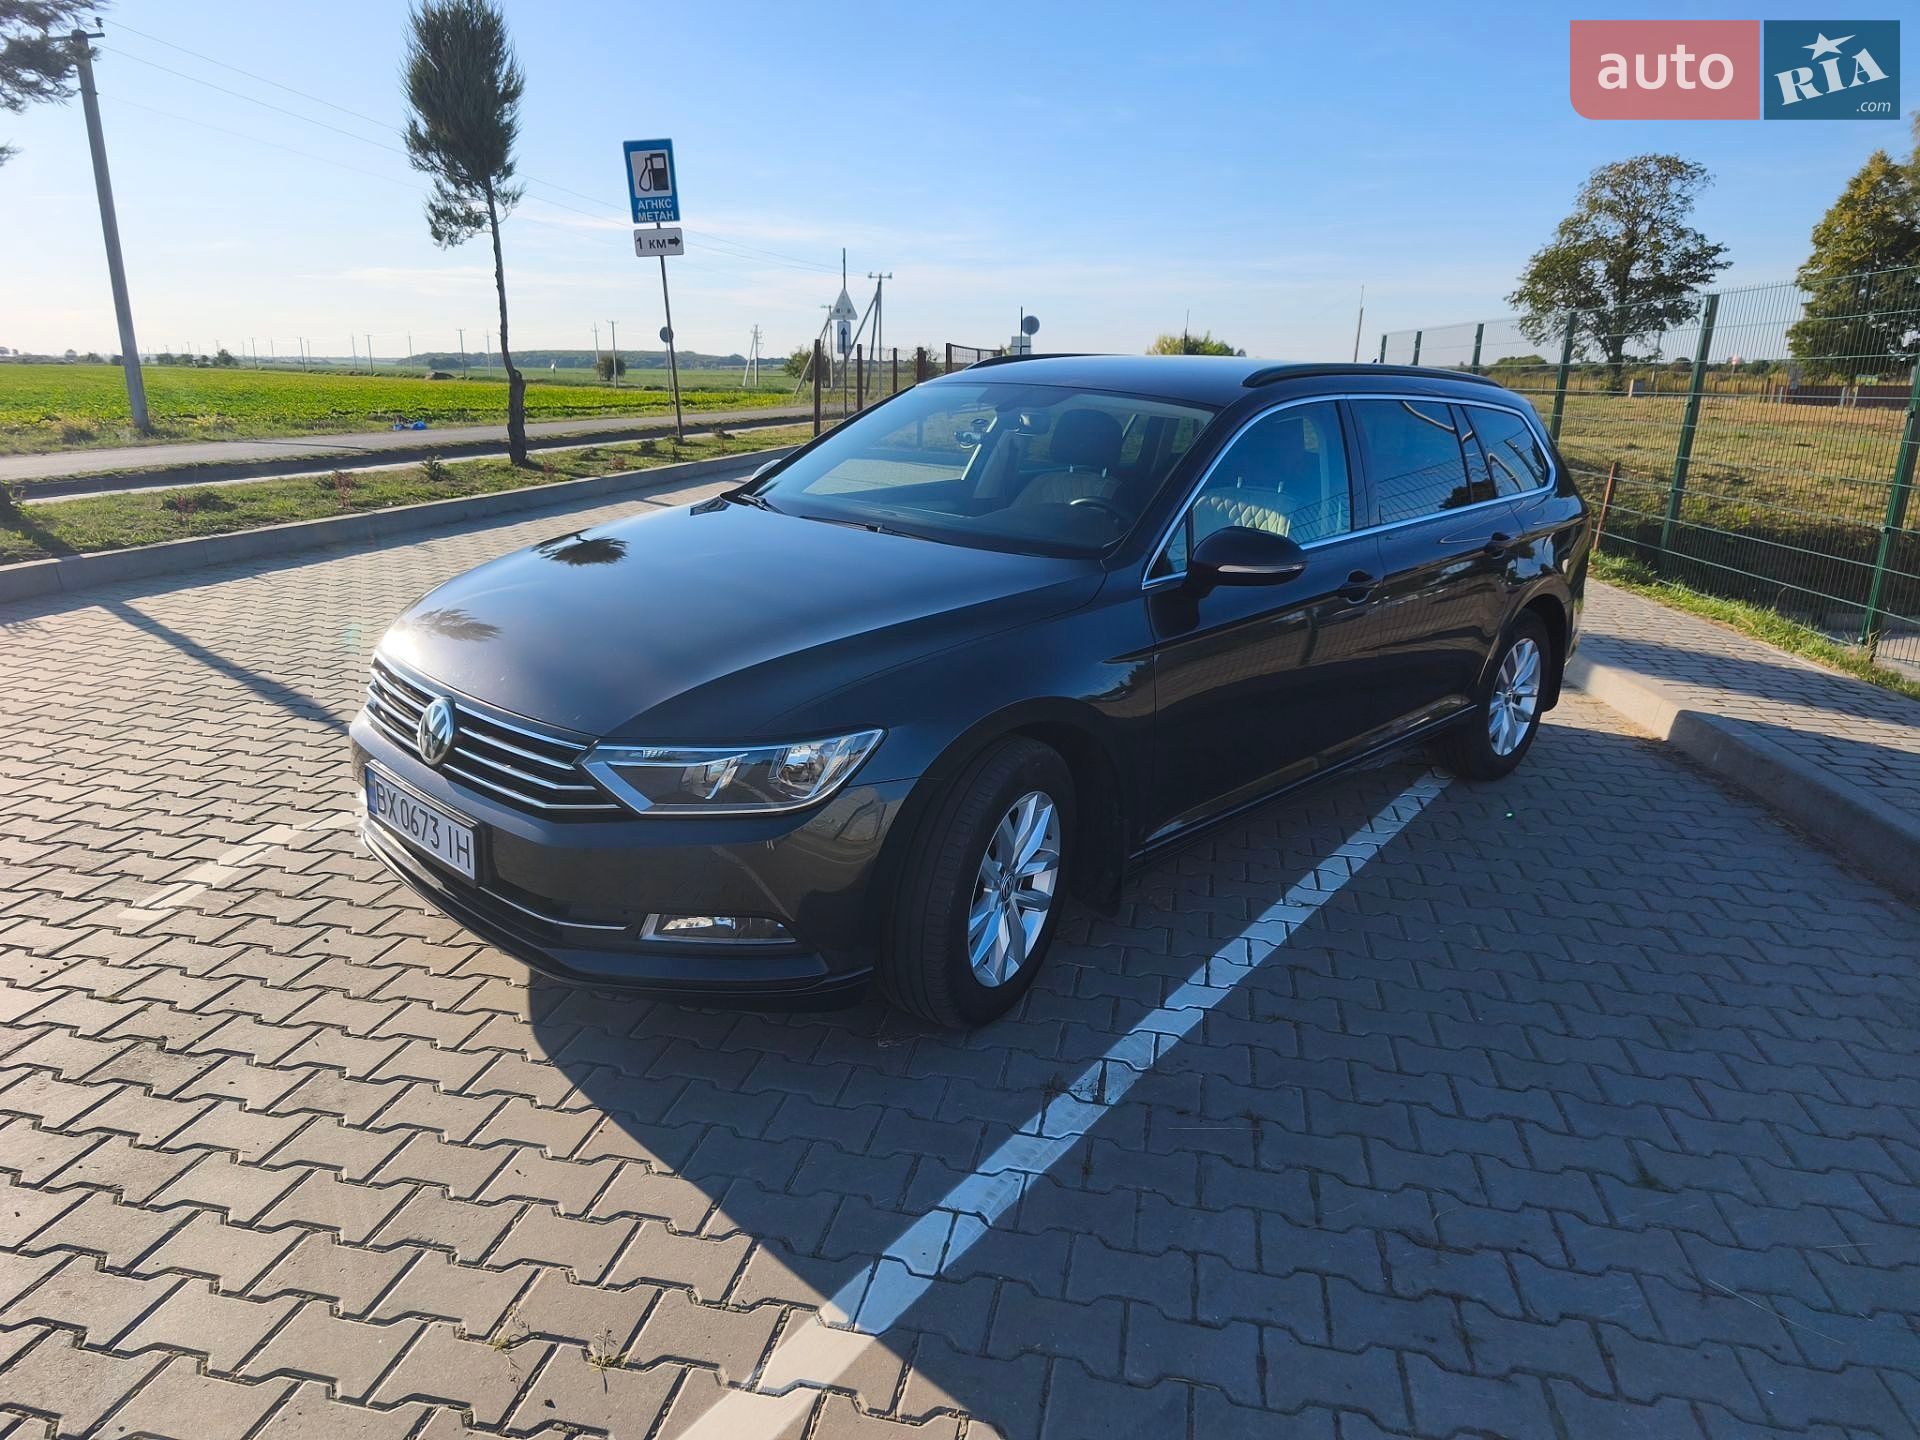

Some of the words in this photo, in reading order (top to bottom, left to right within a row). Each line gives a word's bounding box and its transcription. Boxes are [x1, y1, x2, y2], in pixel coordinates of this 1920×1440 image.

[638, 199, 673, 210] АГНКС
[637, 211, 674, 222] МЕТАН
[636, 236, 643, 250] 1
[400, 798, 440, 850] 0673
